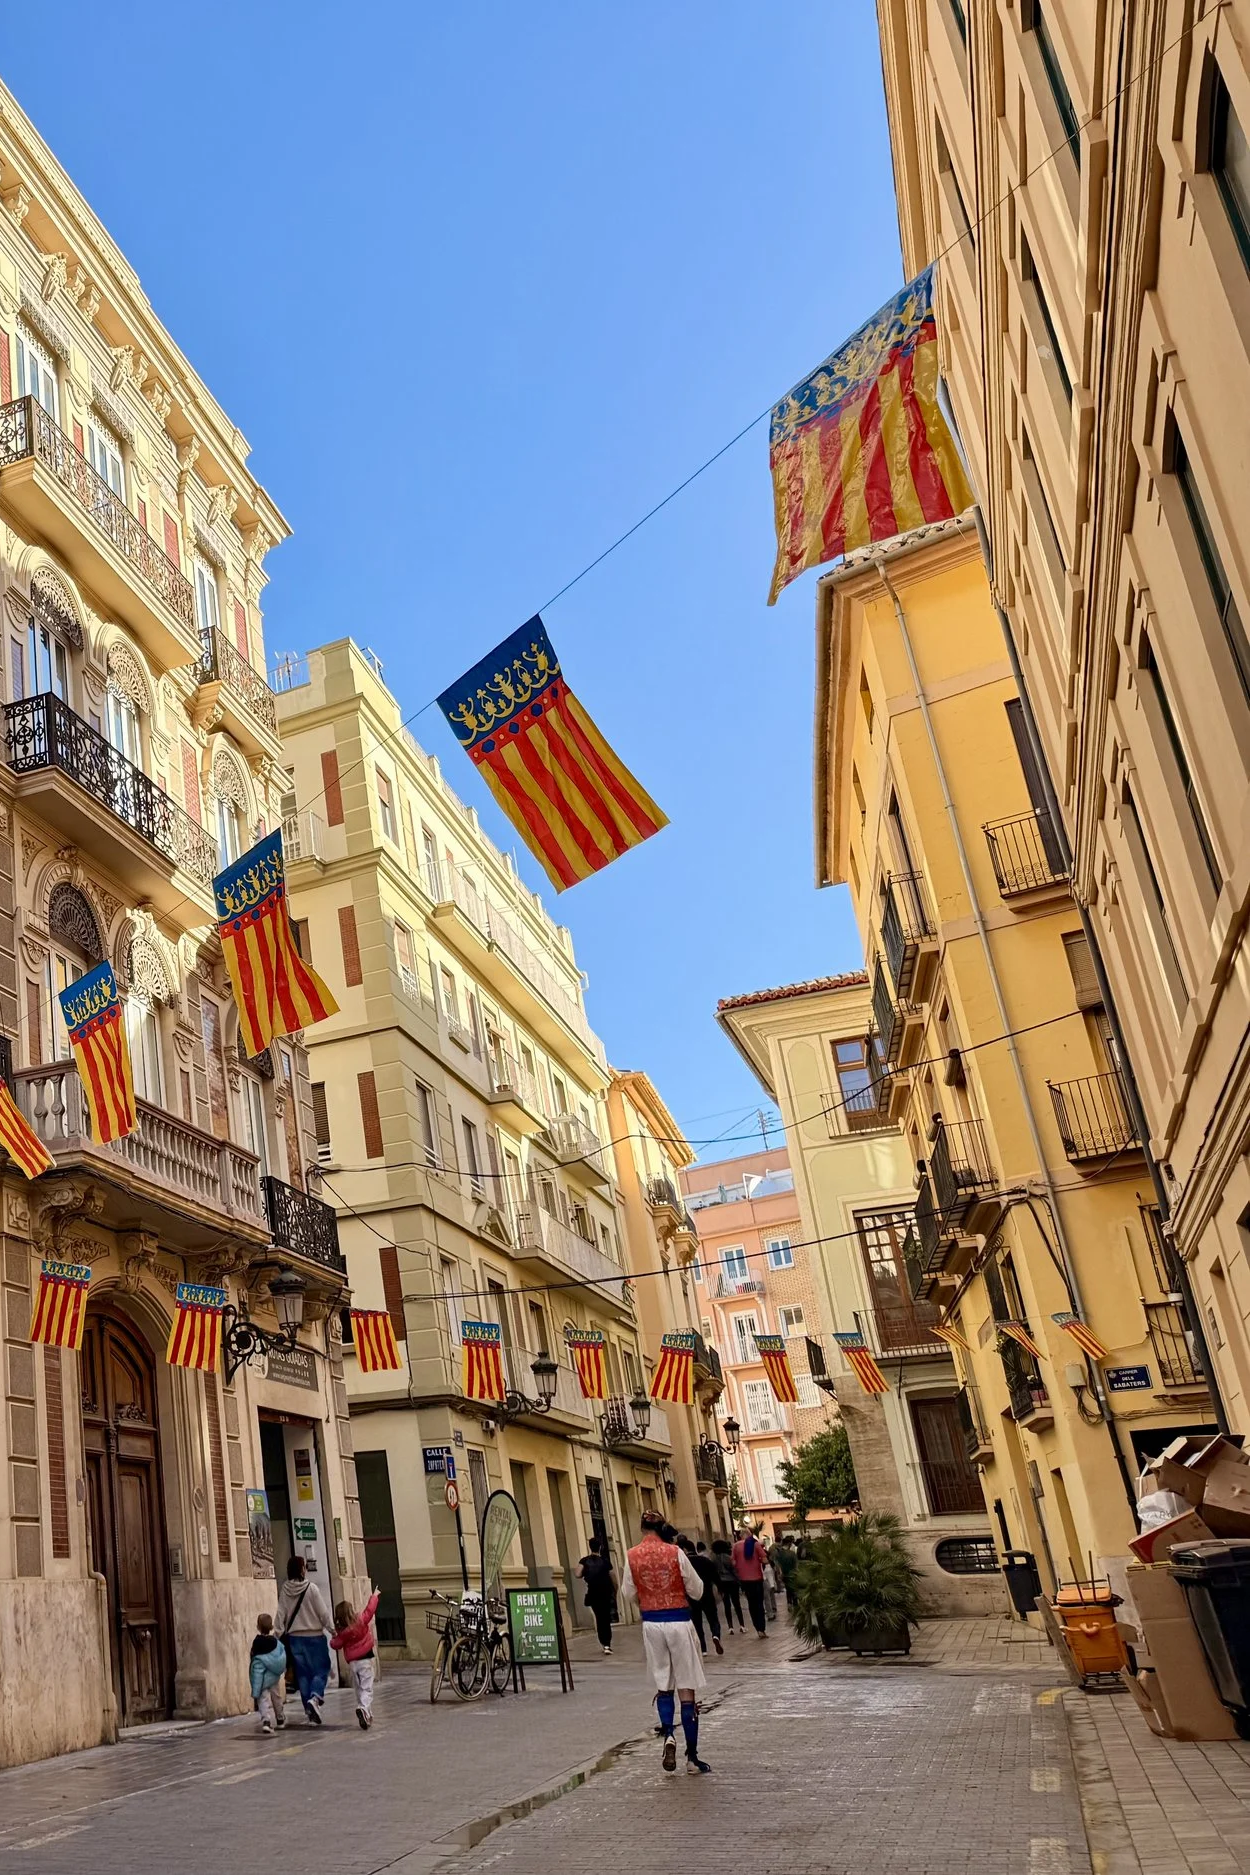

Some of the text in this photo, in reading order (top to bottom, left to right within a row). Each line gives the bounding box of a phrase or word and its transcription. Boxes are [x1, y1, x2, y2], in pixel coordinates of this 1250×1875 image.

[1113, 1380, 1146, 1388] SABATERS
[426, 1448, 447, 1457] CALLE
[516, 1593, 546, 1606] RENT A
[524, 1614, 544, 1627] BIKE
